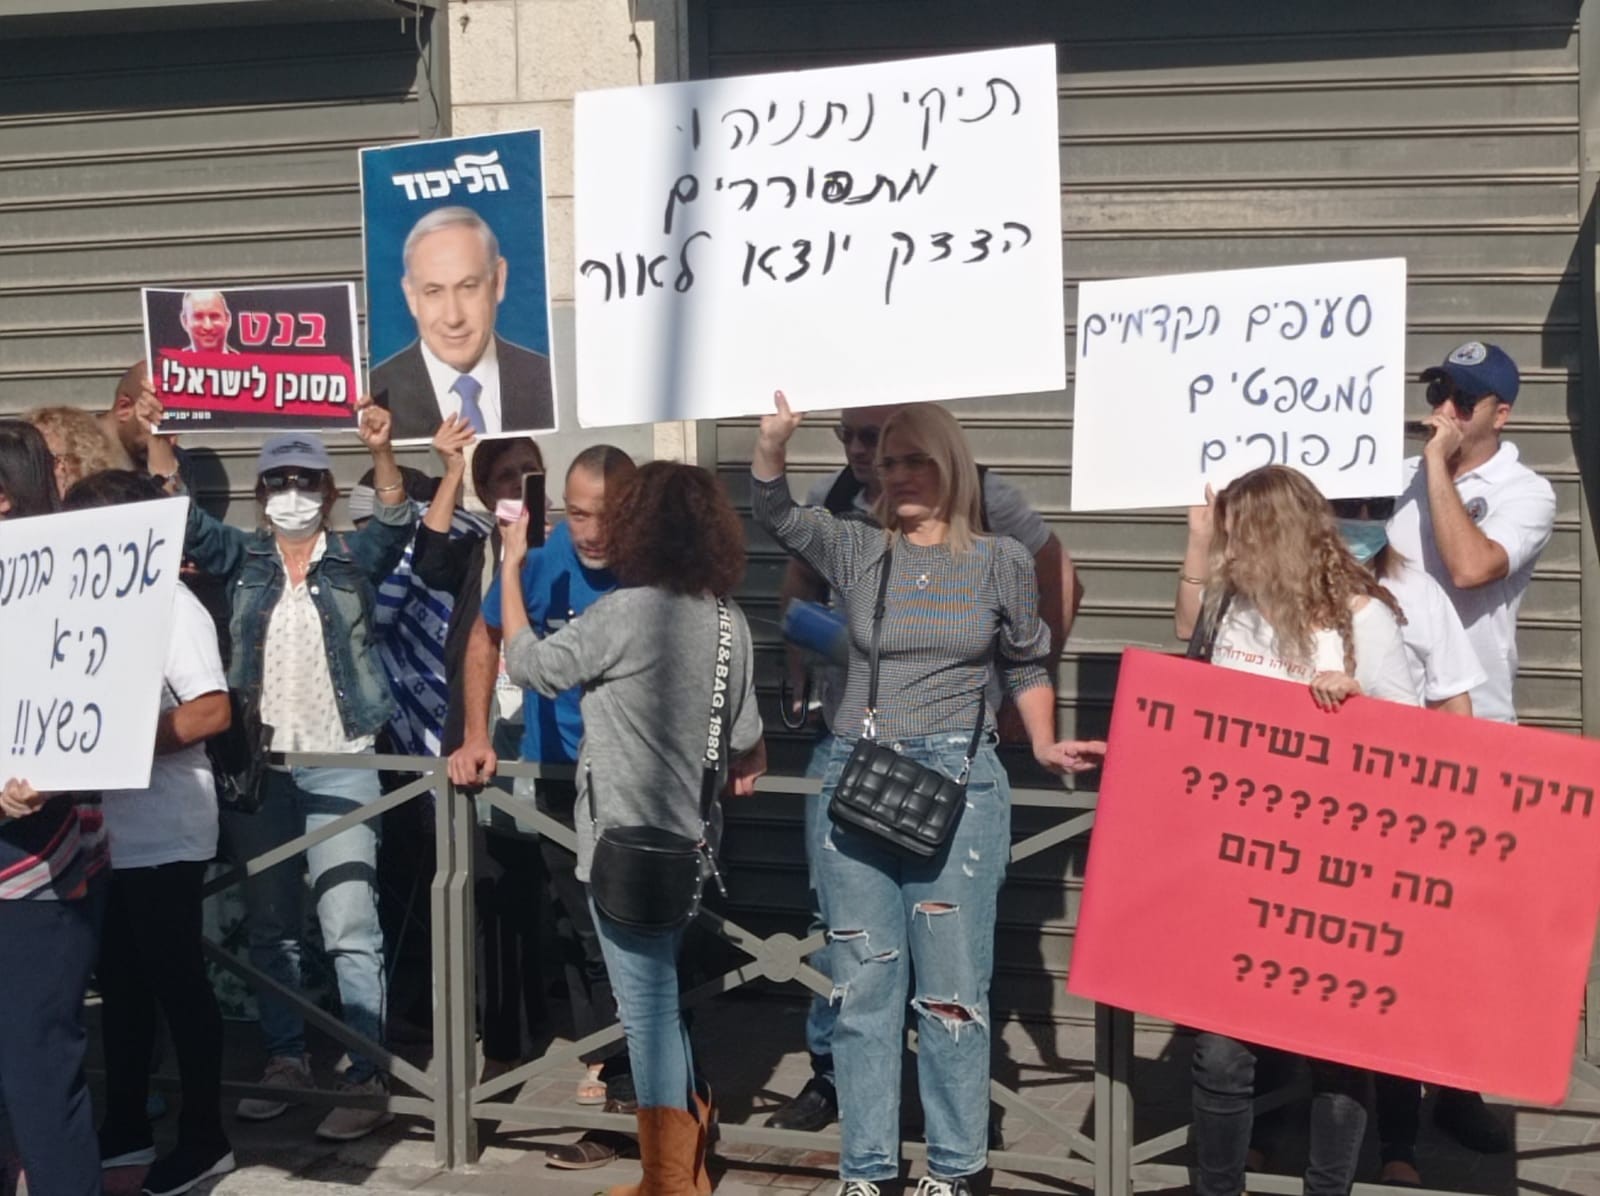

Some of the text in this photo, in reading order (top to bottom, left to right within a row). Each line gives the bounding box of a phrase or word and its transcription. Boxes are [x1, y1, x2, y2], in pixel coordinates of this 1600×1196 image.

[691, 77, 1021, 151] תיקי נתניהו
[392, 151, 509, 200] הליכוד
[580, 231, 712, 301] לאור
[742, 230, 852, 287] יוצא
[238, 311, 326, 347] בנט
[1246, 294, 1372, 342] סעיפים
[161, 359, 347, 407] מסוכן לישראל!
[1189, 365, 1384, 413] למשפטים
[69, 528, 165, 600] אכיפה
[50, 617, 107, 676] היא
[11, 698, 102, 755] פשע!!
[1136, 697, 1594, 817] תיקי נתניהו בשידור חי
[1218, 832, 1455, 909] מה יש להם
[1248, 896, 1404, 956] להסתיר
